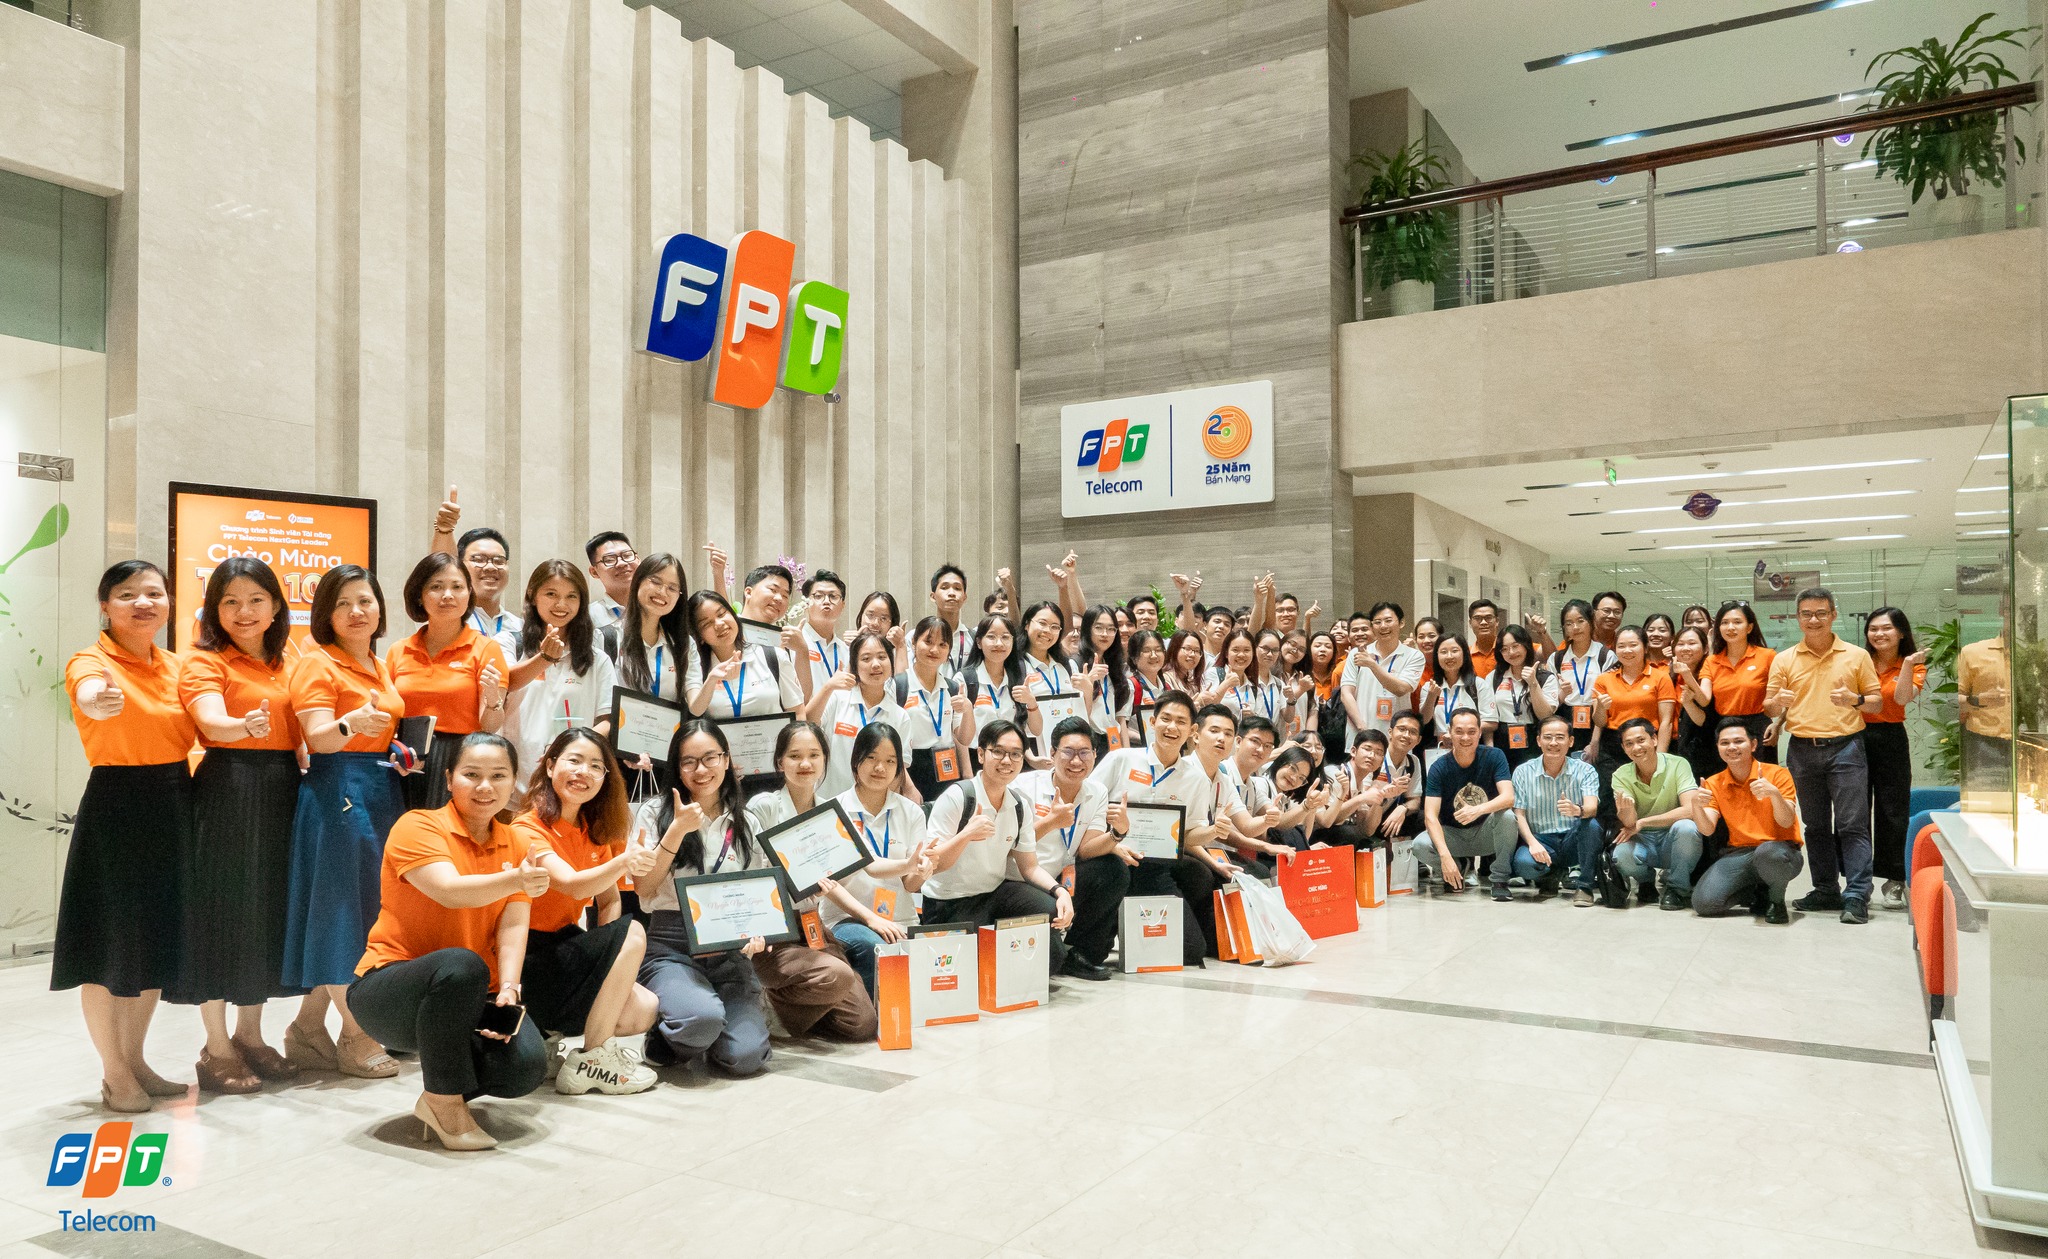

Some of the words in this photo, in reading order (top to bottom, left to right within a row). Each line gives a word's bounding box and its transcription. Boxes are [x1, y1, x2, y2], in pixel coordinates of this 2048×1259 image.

[660, 260, 842, 365] FPT
[1081, 432, 1145, 459] FPT
[1205, 463, 1220, 475] 25
[1221, 461, 1251, 474] Năm
[1085, 478, 1143, 496] Telecom
[1225, 473, 1251, 485] Mạng
[239, 534, 268, 542] Telecom
[575, 1061, 618, 1086] PUMA
